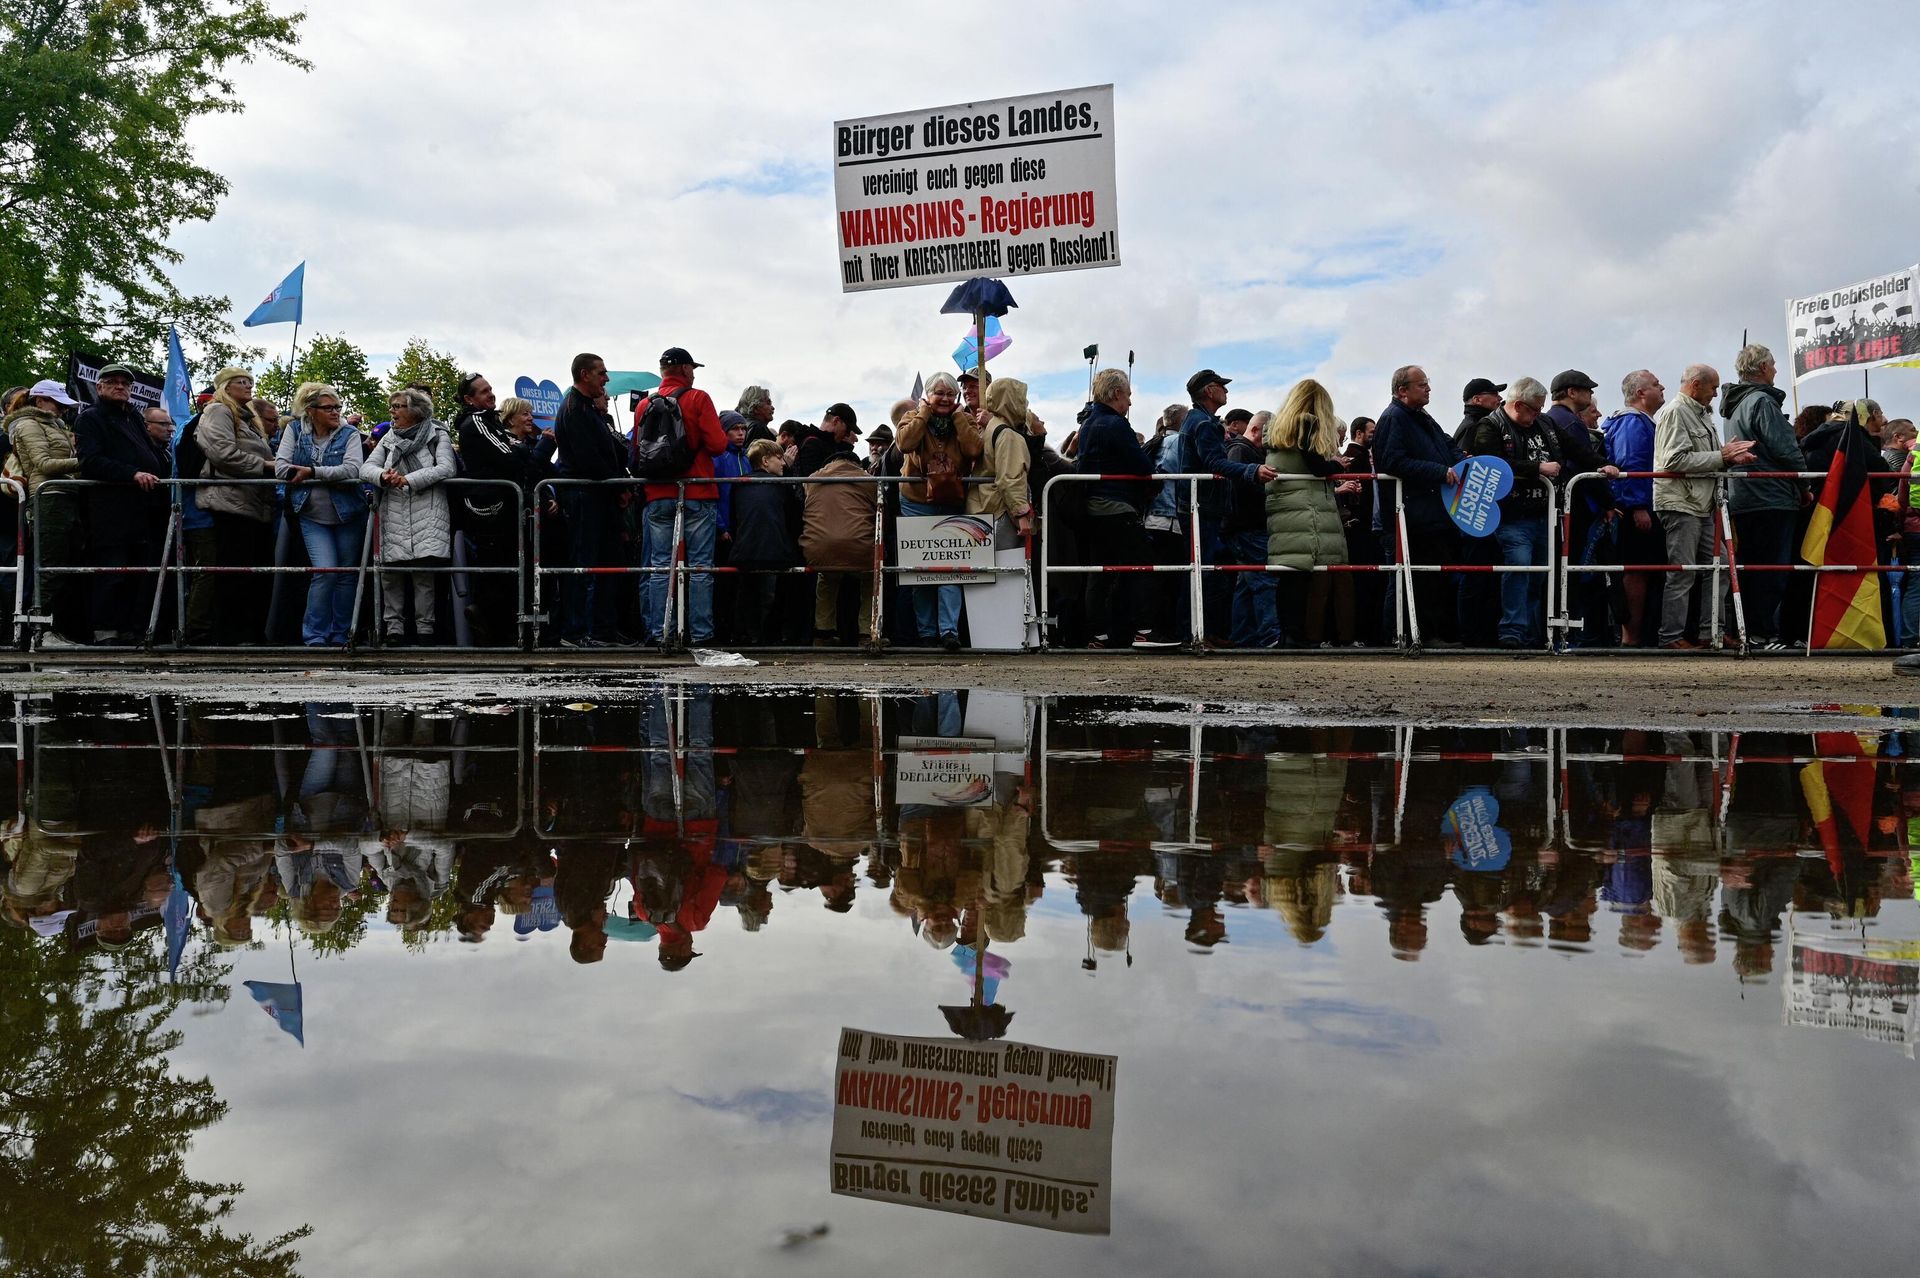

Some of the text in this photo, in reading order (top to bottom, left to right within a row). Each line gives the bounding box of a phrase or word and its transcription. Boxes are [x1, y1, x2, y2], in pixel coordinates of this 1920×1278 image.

[838, 100, 1099, 157] Bürger dieses Landes,
[863, 157, 1046, 196] vereinigt euch gegen diese
[844, 254, 864, 284] mit
[871, 253, 899, 281] ihrer
[904, 239, 1001, 277] KRIEGSTREIBEREI
[1007, 239, 1046, 273] gegen
[1796, 277, 1911, 317] Freie Oebisfelder
[80, 366, 97, 381] AMI
[1805, 345, 1848, 369] ROTE
[521, 387, 559, 400] UNSER LAND
[1456, 461, 1489, 525] ZUERST!
[1473, 468, 1502, 531] UNSER LAND
[901, 538, 992, 549] DEUTSCHLAND
[922, 550, 971, 561] ZUERST!
